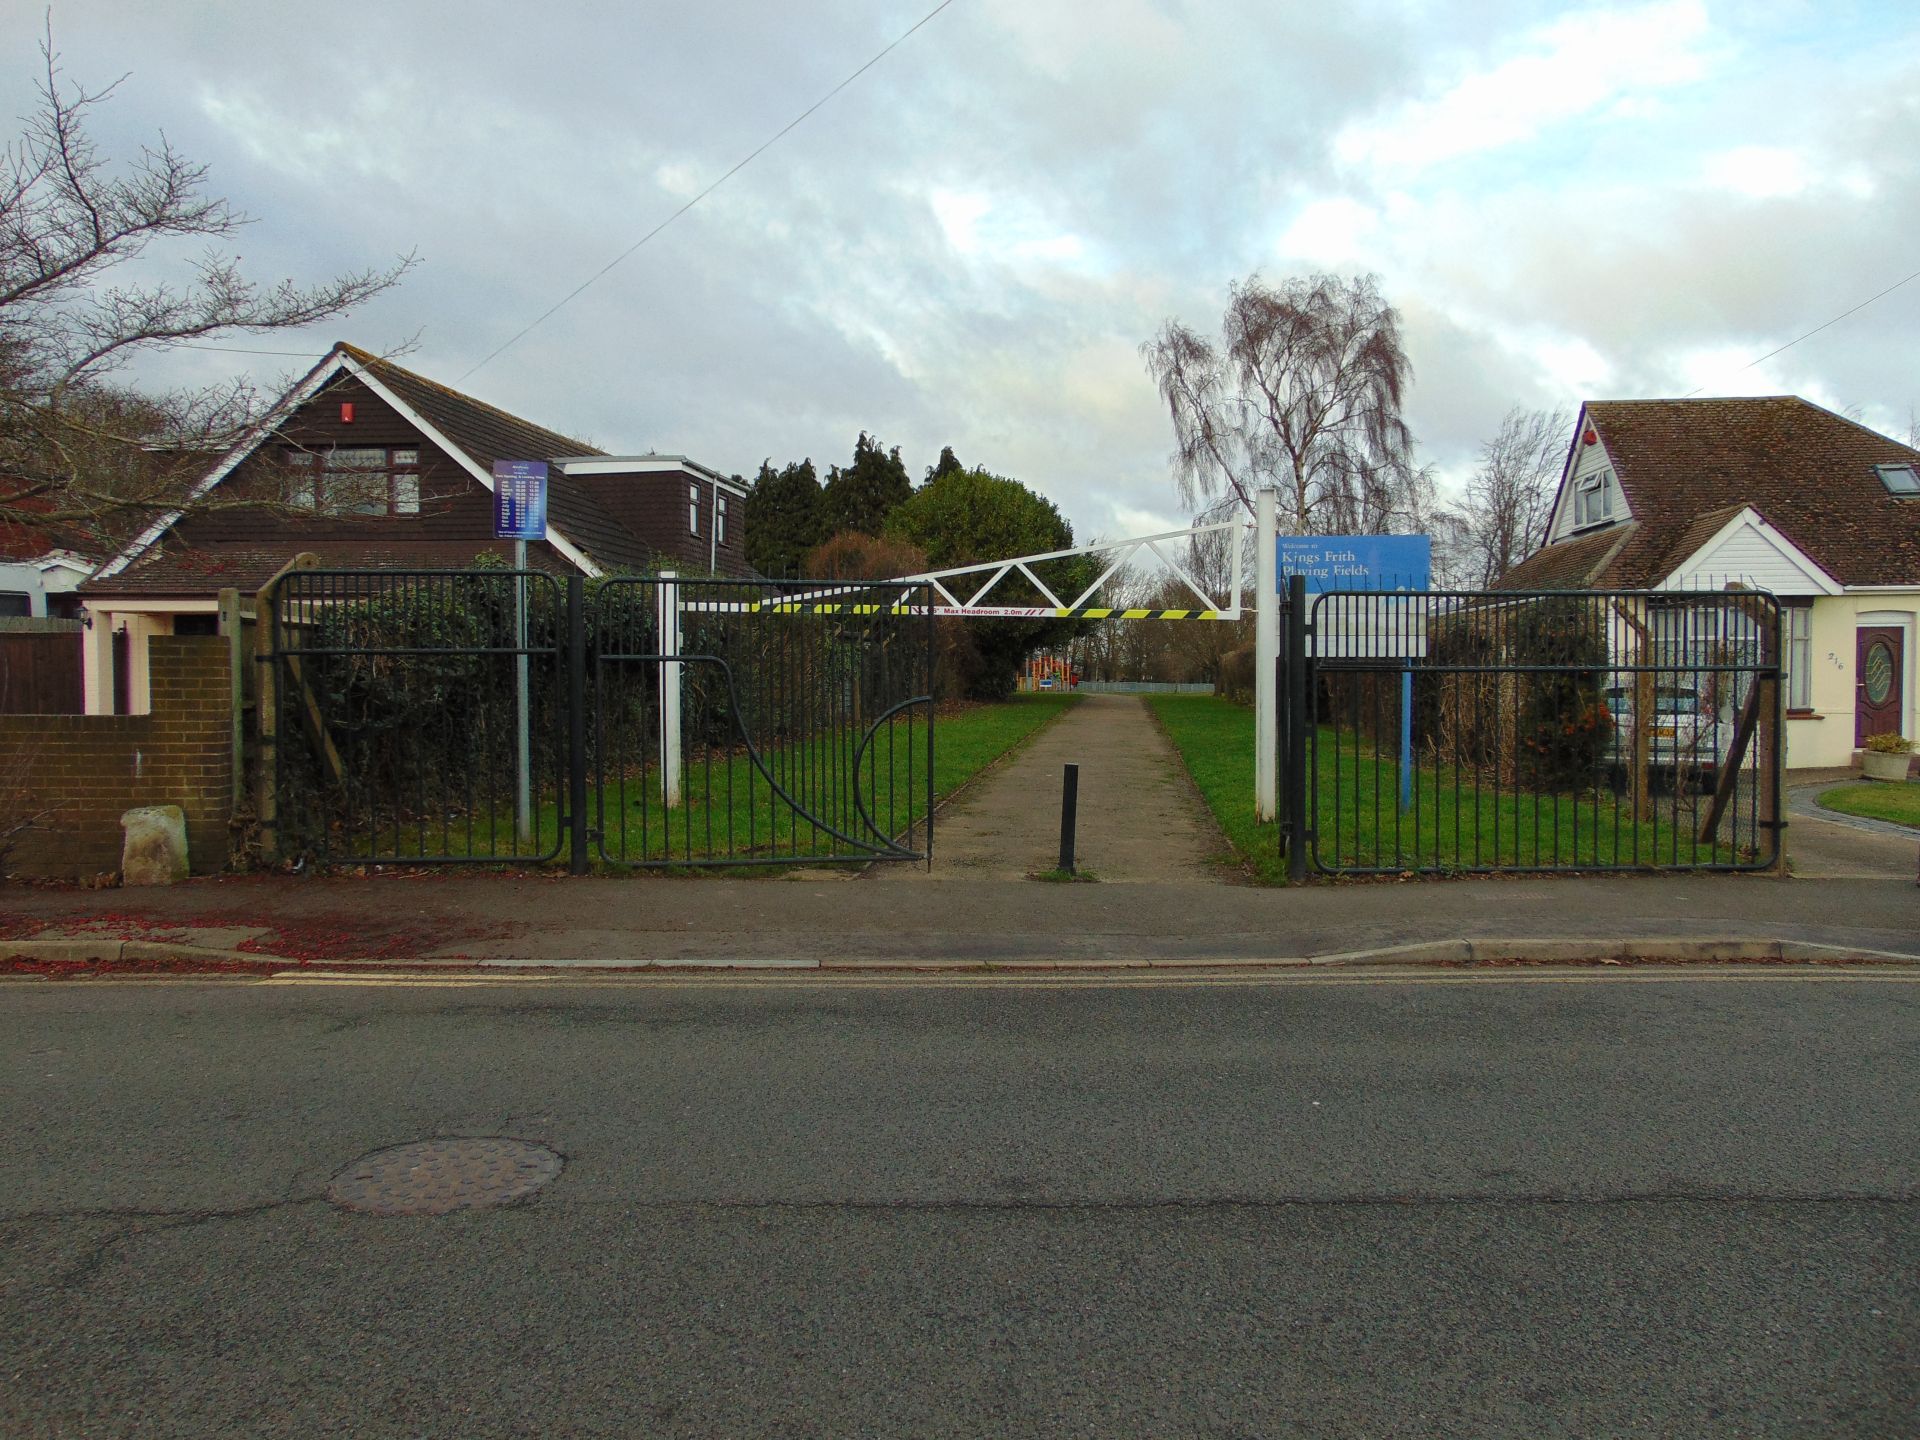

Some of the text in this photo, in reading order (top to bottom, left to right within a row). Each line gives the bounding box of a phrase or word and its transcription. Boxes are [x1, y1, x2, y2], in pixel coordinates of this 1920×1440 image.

[1282, 550, 1355, 564] Kings Frith
[1334, 564, 1369, 576] Fields
[1828, 652, 1844, 670] 216
